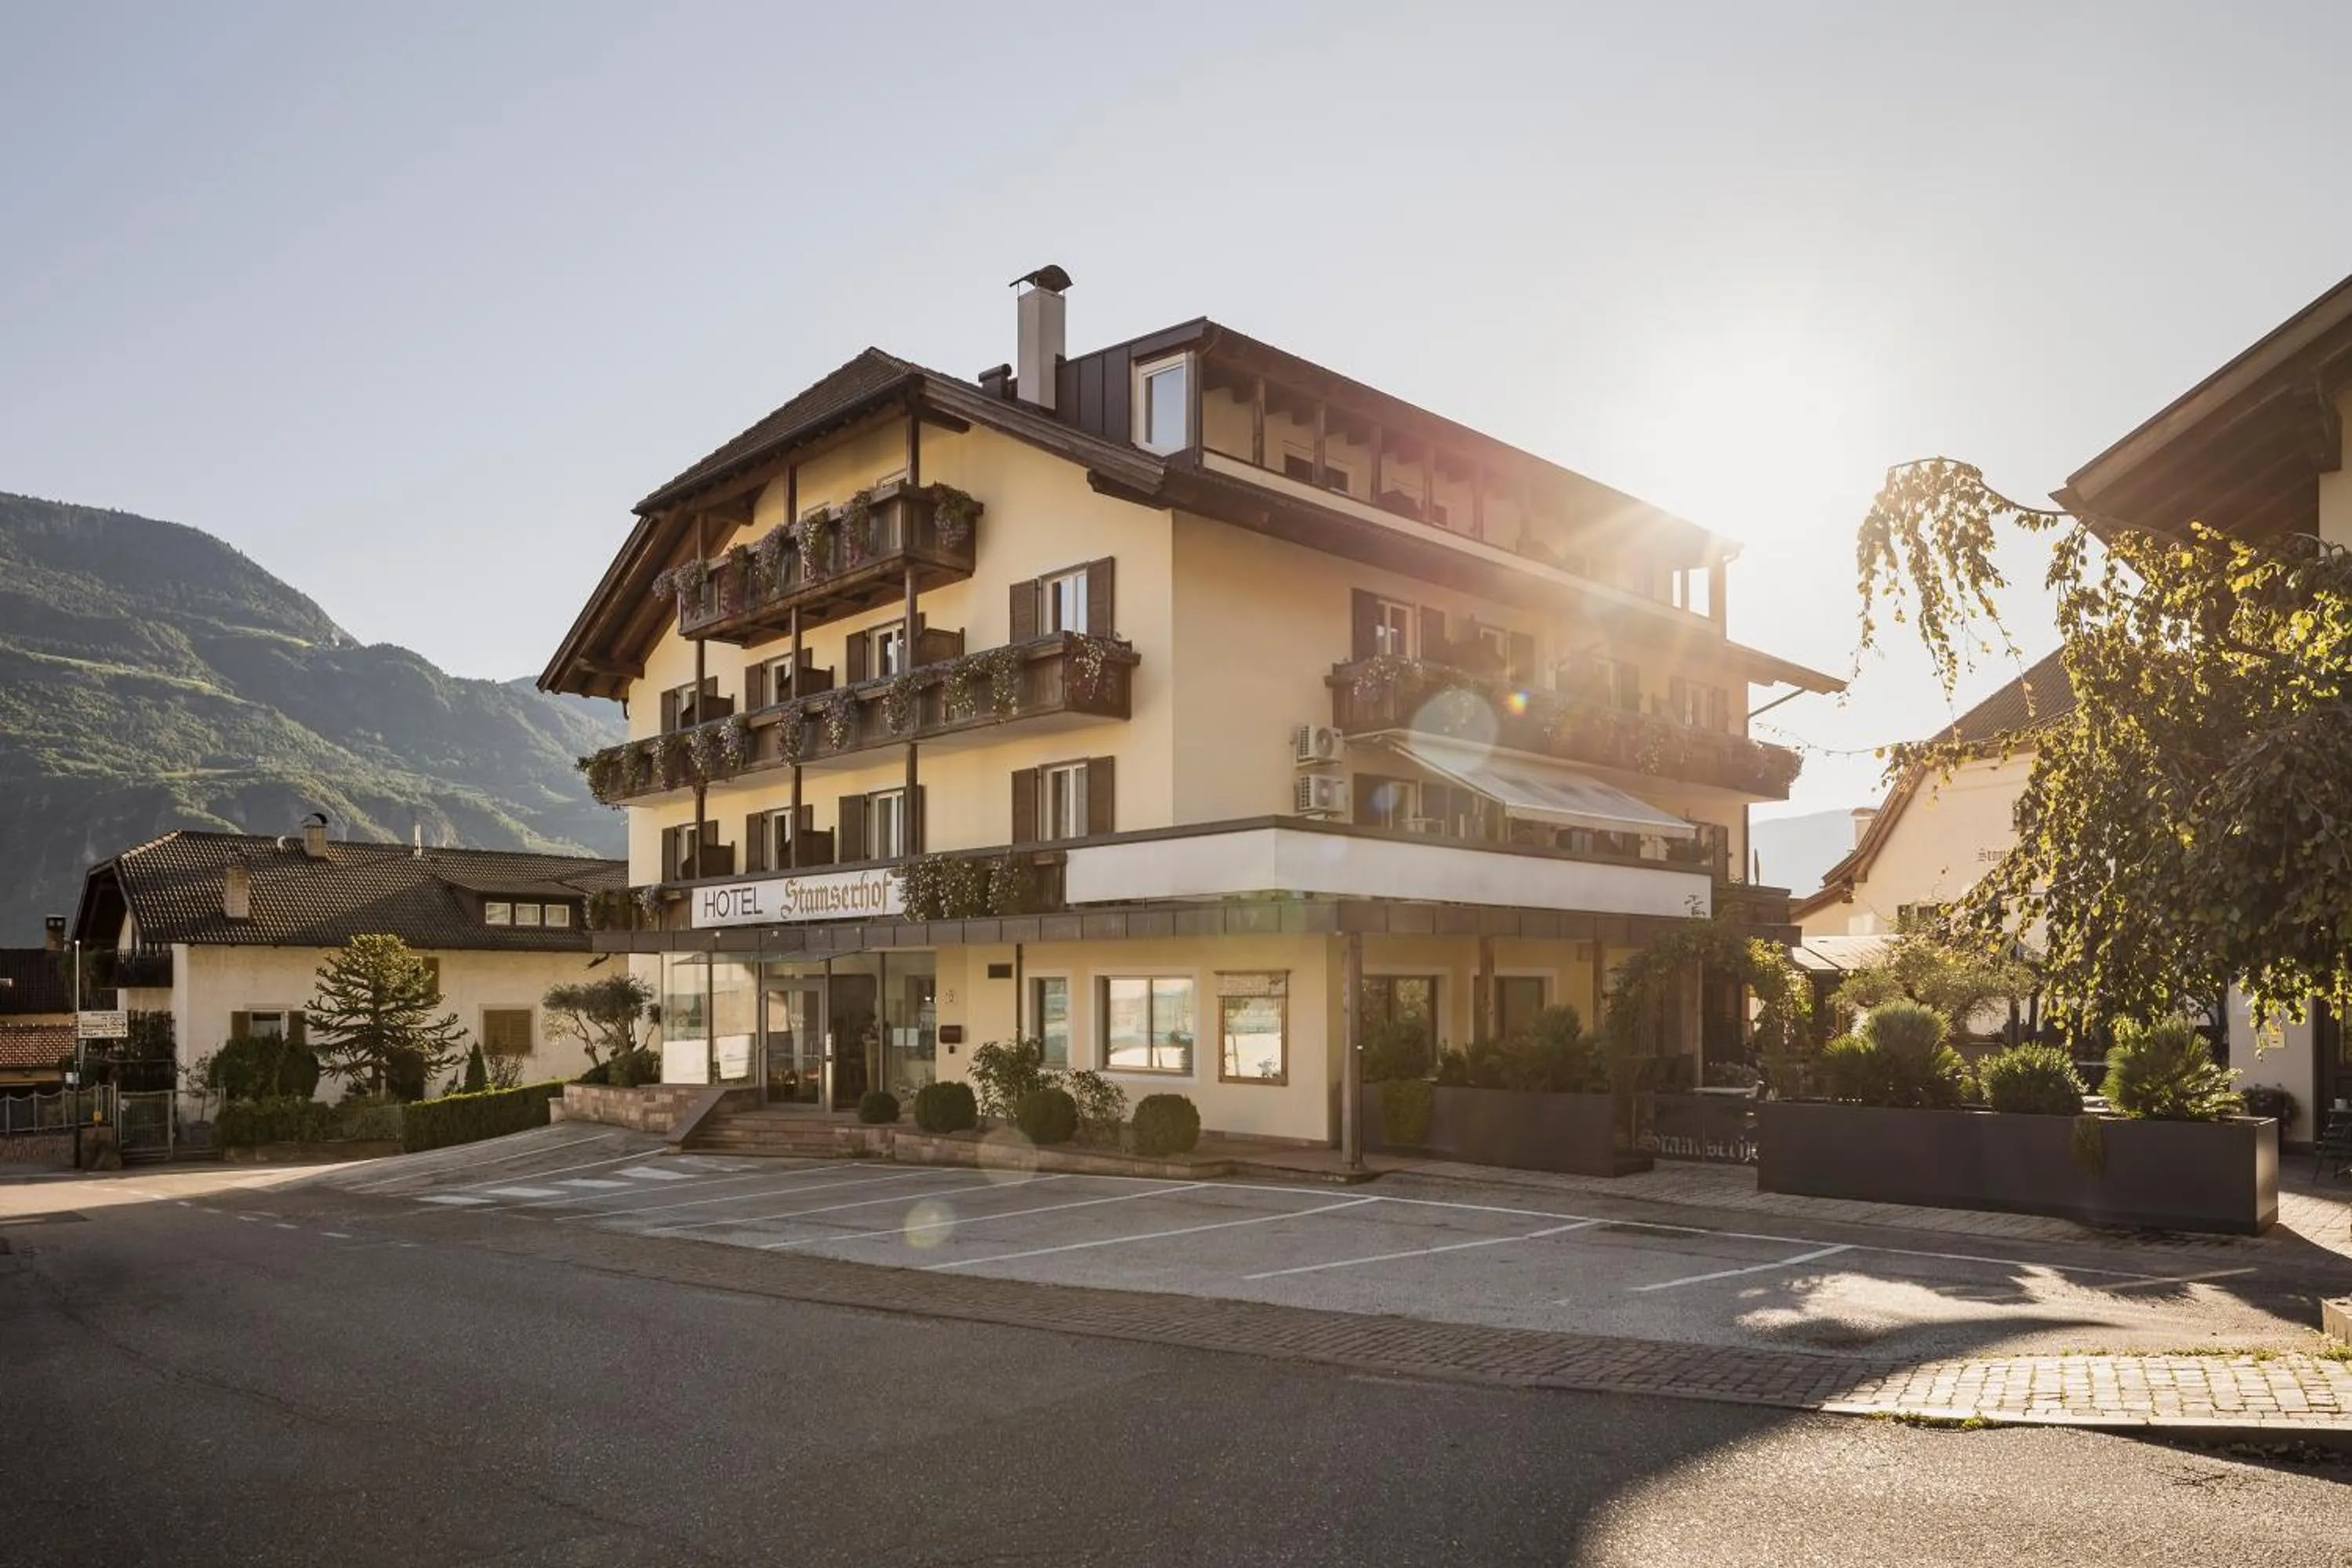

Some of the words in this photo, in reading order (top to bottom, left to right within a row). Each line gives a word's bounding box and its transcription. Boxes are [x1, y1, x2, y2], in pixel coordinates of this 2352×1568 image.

[704, 886, 763, 917] HOTEL
[781, 870, 892, 919] Stamserhof
[1636, 1127, 1759, 1163] Stamserh
